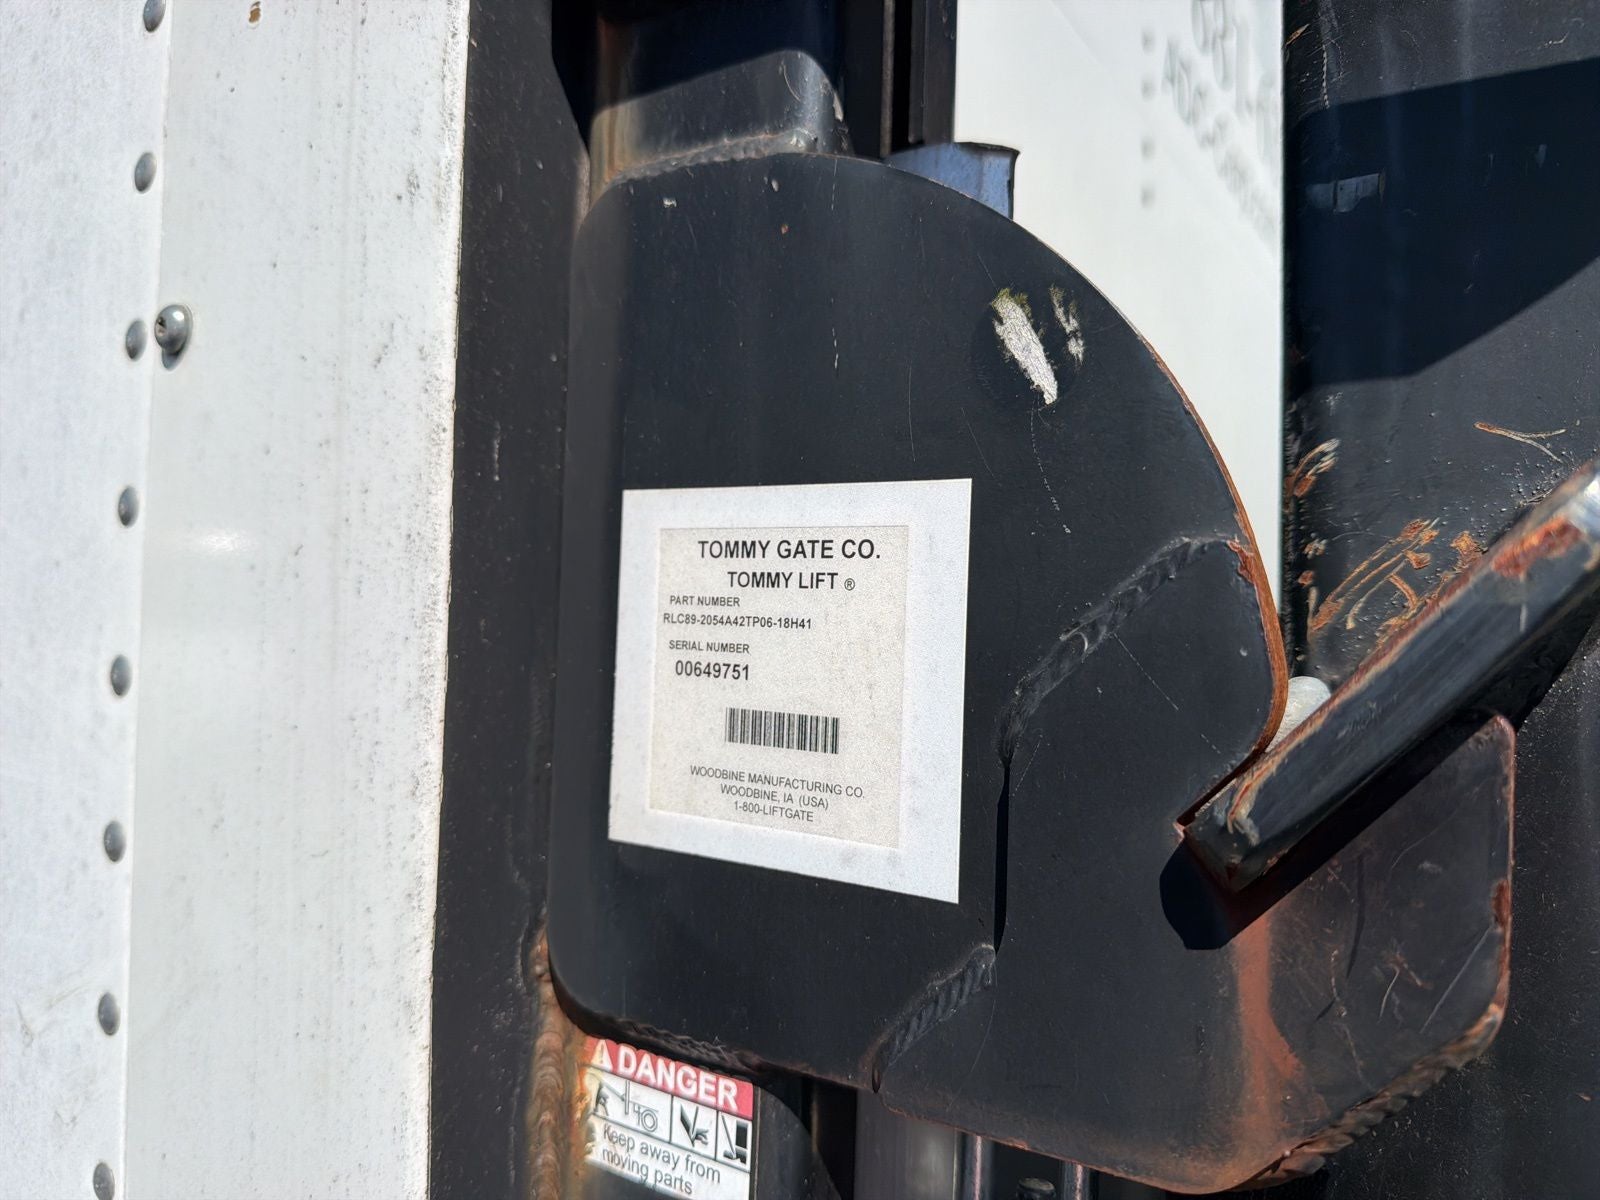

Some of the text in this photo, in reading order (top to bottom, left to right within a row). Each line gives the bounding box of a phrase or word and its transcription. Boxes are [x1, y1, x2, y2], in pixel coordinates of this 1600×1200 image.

[698, 539, 881, 559] TOMMY GATE CO.
[727, 571, 793, 589] TOMMY
[798, 572, 839, 590] LIFT
[669, 595, 741, 607] PART NUMBER
[663, 613, 812, 629] RLC89-2054A42TP06-18H41
[669, 640, 750, 654] SERIAL NUMBER
[675, 660, 750, 680] 00649751
[690, 765, 745, 782] WOODBINE
[748, 773, 842, 796] MANUFACTURING
[720, 783, 829, 811] WOODBINE, IA (USA)
[734, 801, 814, 822] 1-800-LIFTGATE
[617, 1045, 738, 1112] DANGER
[603, 1123, 721, 1184] Keep away from
[602, 1149, 693, 1195] moving parts
